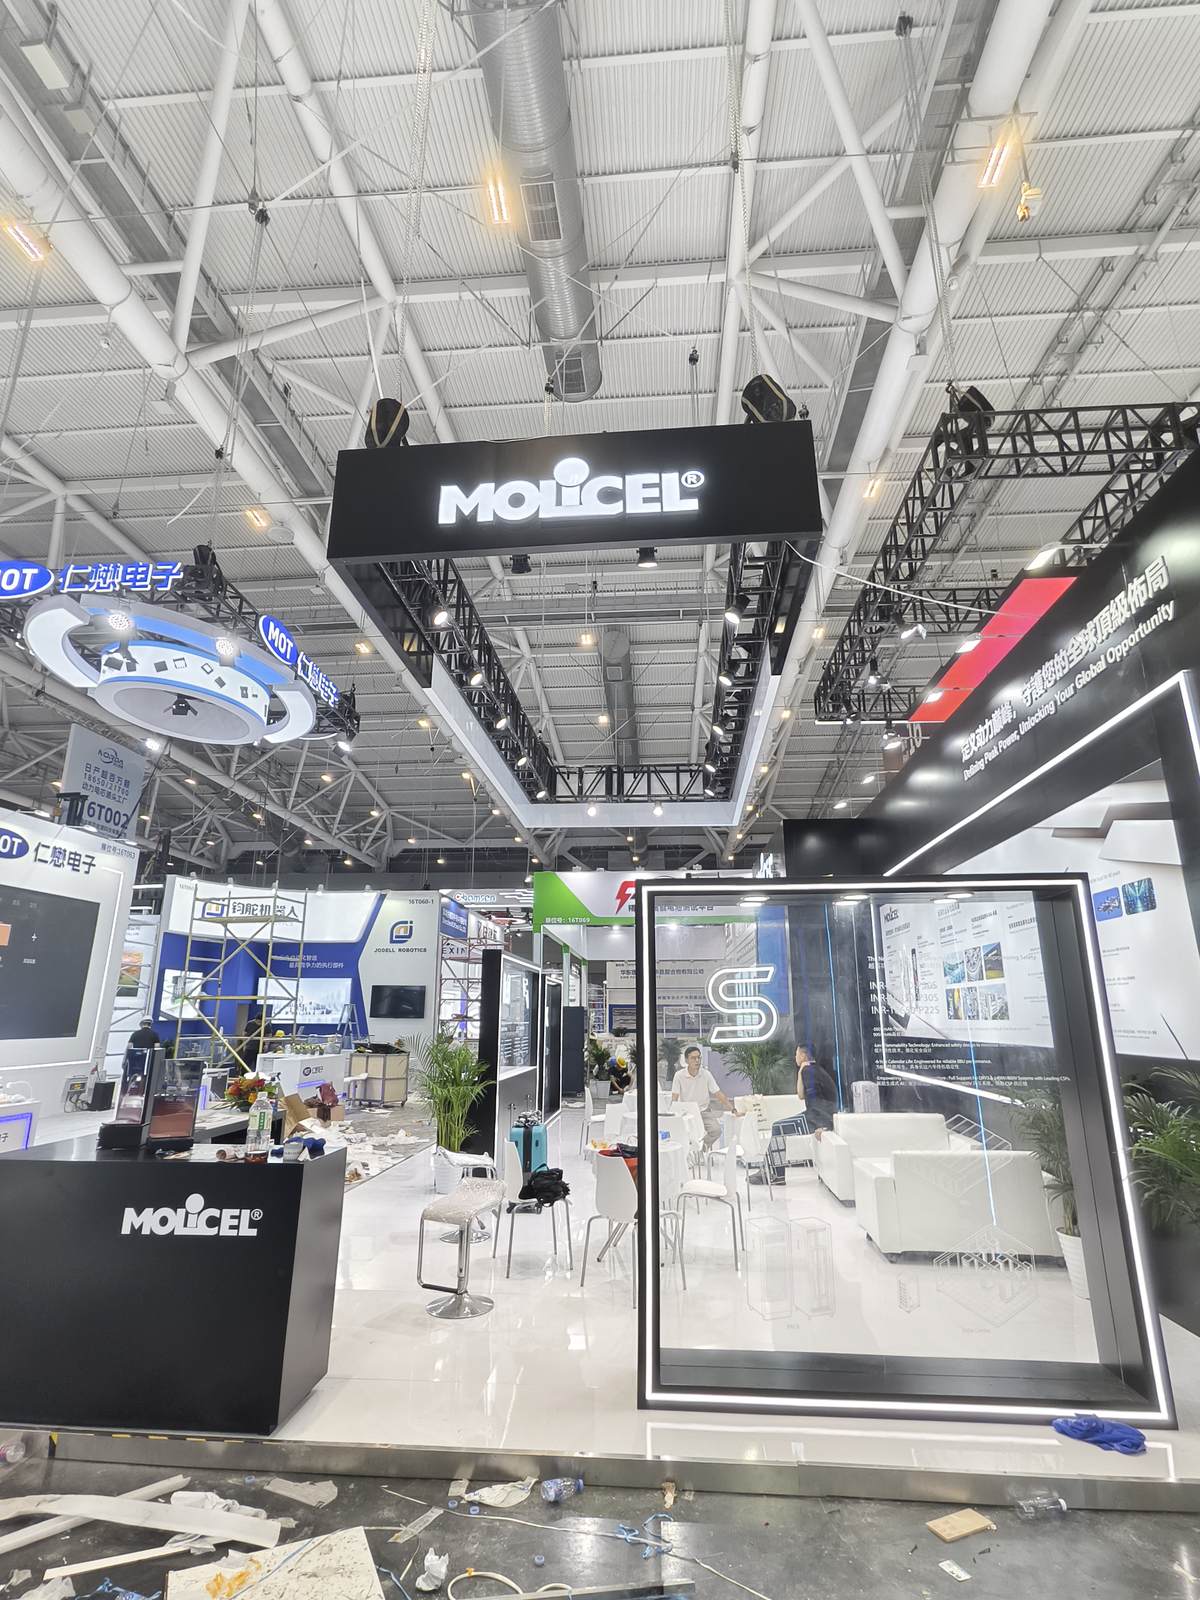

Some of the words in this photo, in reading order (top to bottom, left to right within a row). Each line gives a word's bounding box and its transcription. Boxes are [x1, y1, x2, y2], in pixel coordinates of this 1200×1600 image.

[0, 568, 39, 591] OT
[267, 620, 294, 660] MOT
[963, 758, 985, 781] Defining
[984, 745, 999, 764] Peak
[1018, 700, 1055, 735] Unlocking
[1054, 683, 1075, 705] Your
[1074, 654, 1107, 689] Global
[1106, 600, 1175, 663] Opportunity
[0, 834, 22, 856] OT
